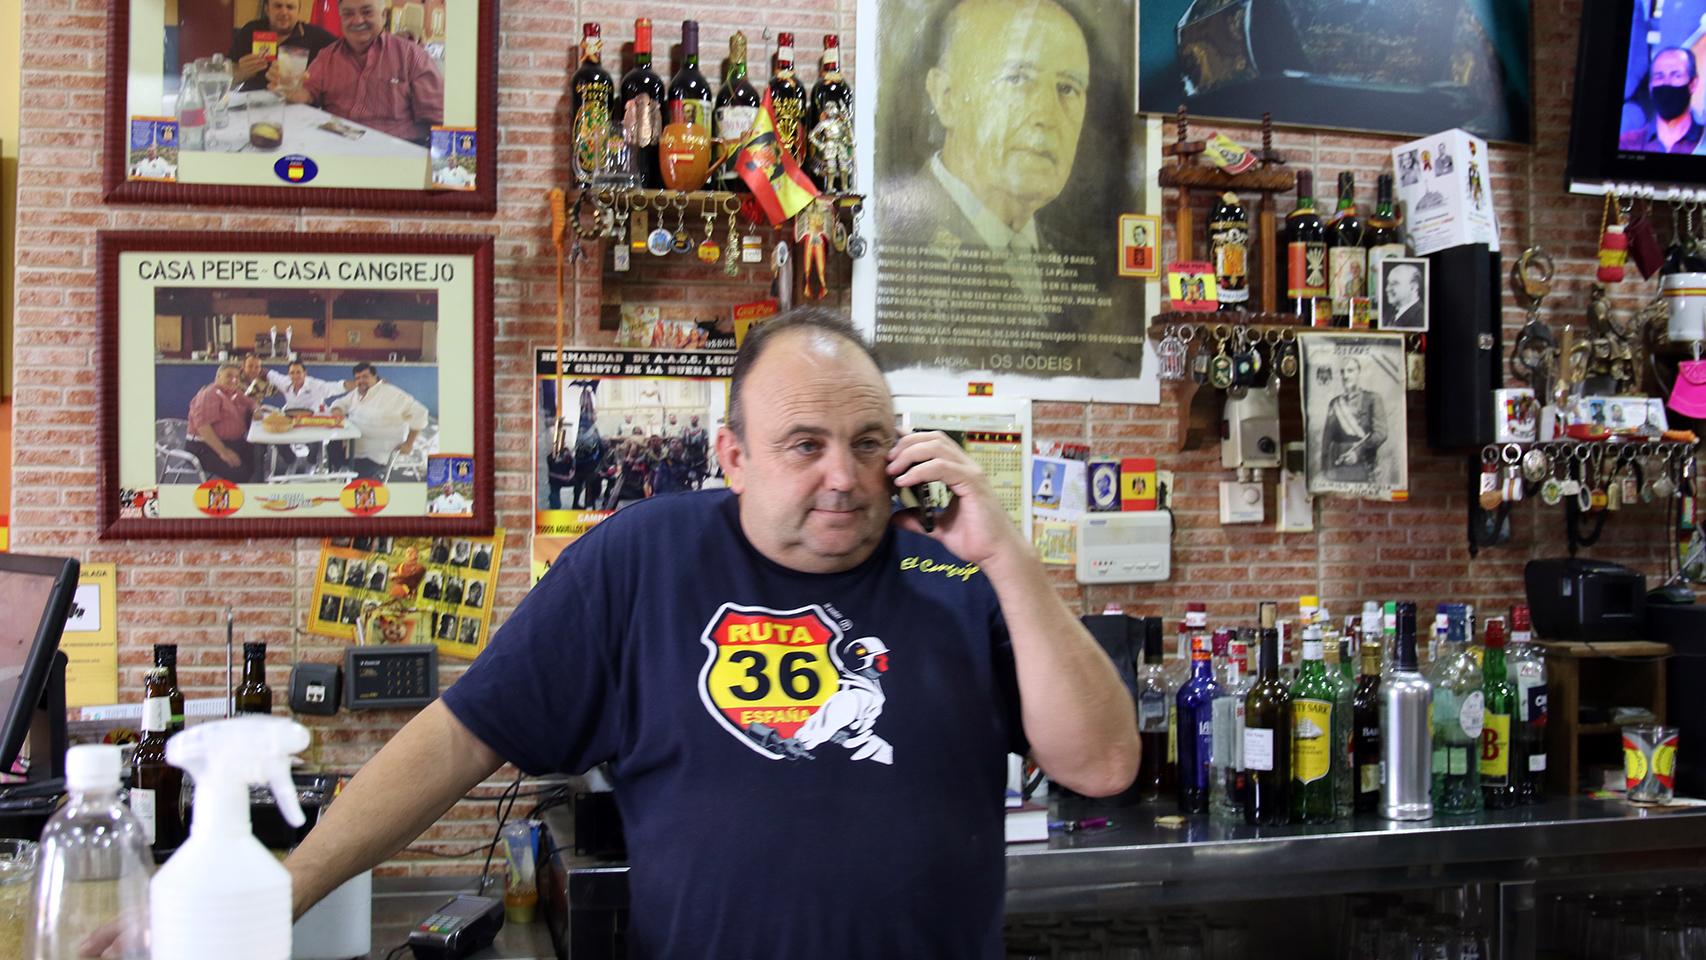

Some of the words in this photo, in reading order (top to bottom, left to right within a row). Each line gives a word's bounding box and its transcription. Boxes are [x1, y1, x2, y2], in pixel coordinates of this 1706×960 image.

[138, 260, 195, 280] CASA
[273, 260, 331, 281] CASA
[338, 262, 455, 283] CANGREJO
[961, 263, 968, 272] A
[969, 263, 983, 273] LOS
[1045, 268, 1055, 277] LA
[1056, 268, 1078, 278] PLAYA
[952, 277, 987, 286] HACEROS
[1049, 282, 1059, 290] EN
[1061, 282, 1069, 291] EL
[952, 290, 960, 299] EL
[1043, 296, 1053, 305] LA
[1076, 297, 1096, 306] PARA
[1097, 297, 1113, 307] QUE
[986, 302, 997, 310] EN
[877, 310, 904, 320] NUNCA
[906, 312, 916, 321] OS
[951, 313, 965, 322] LAS
[1006, 316, 1016, 325] DE
[876, 324, 908, 333] CUANDO
[938, 327, 951, 336] LAS
[1005, 330, 1019, 338] LOS
[1031, 331, 1076, 343] RESULTADOS
[1088, 334, 1098, 342] OS
[876, 334, 893, 343] UNO
[929, 336, 940, 345] LA
[705, 338, 736, 349] OSBOR
[633, 354, 650, 364] DE
[706, 356, 738, 366] LEGI
[990, 354, 1013, 369] OS
[1017, 355, 1073, 372] JODEIS
[562, 363, 570, 373] Y
[575, 363, 620, 374] CRISTO
[624, 365, 642, 375] DE
[646, 365, 664, 375] LA
[668, 365, 712, 376] BUENA
[577, 512, 614, 523] CAMPA
[900, 556, 920, 570] El
[727, 622, 815, 644] RUTA
[728, 650, 821, 701] 36
[740, 707, 811, 725] ESPAÑA
